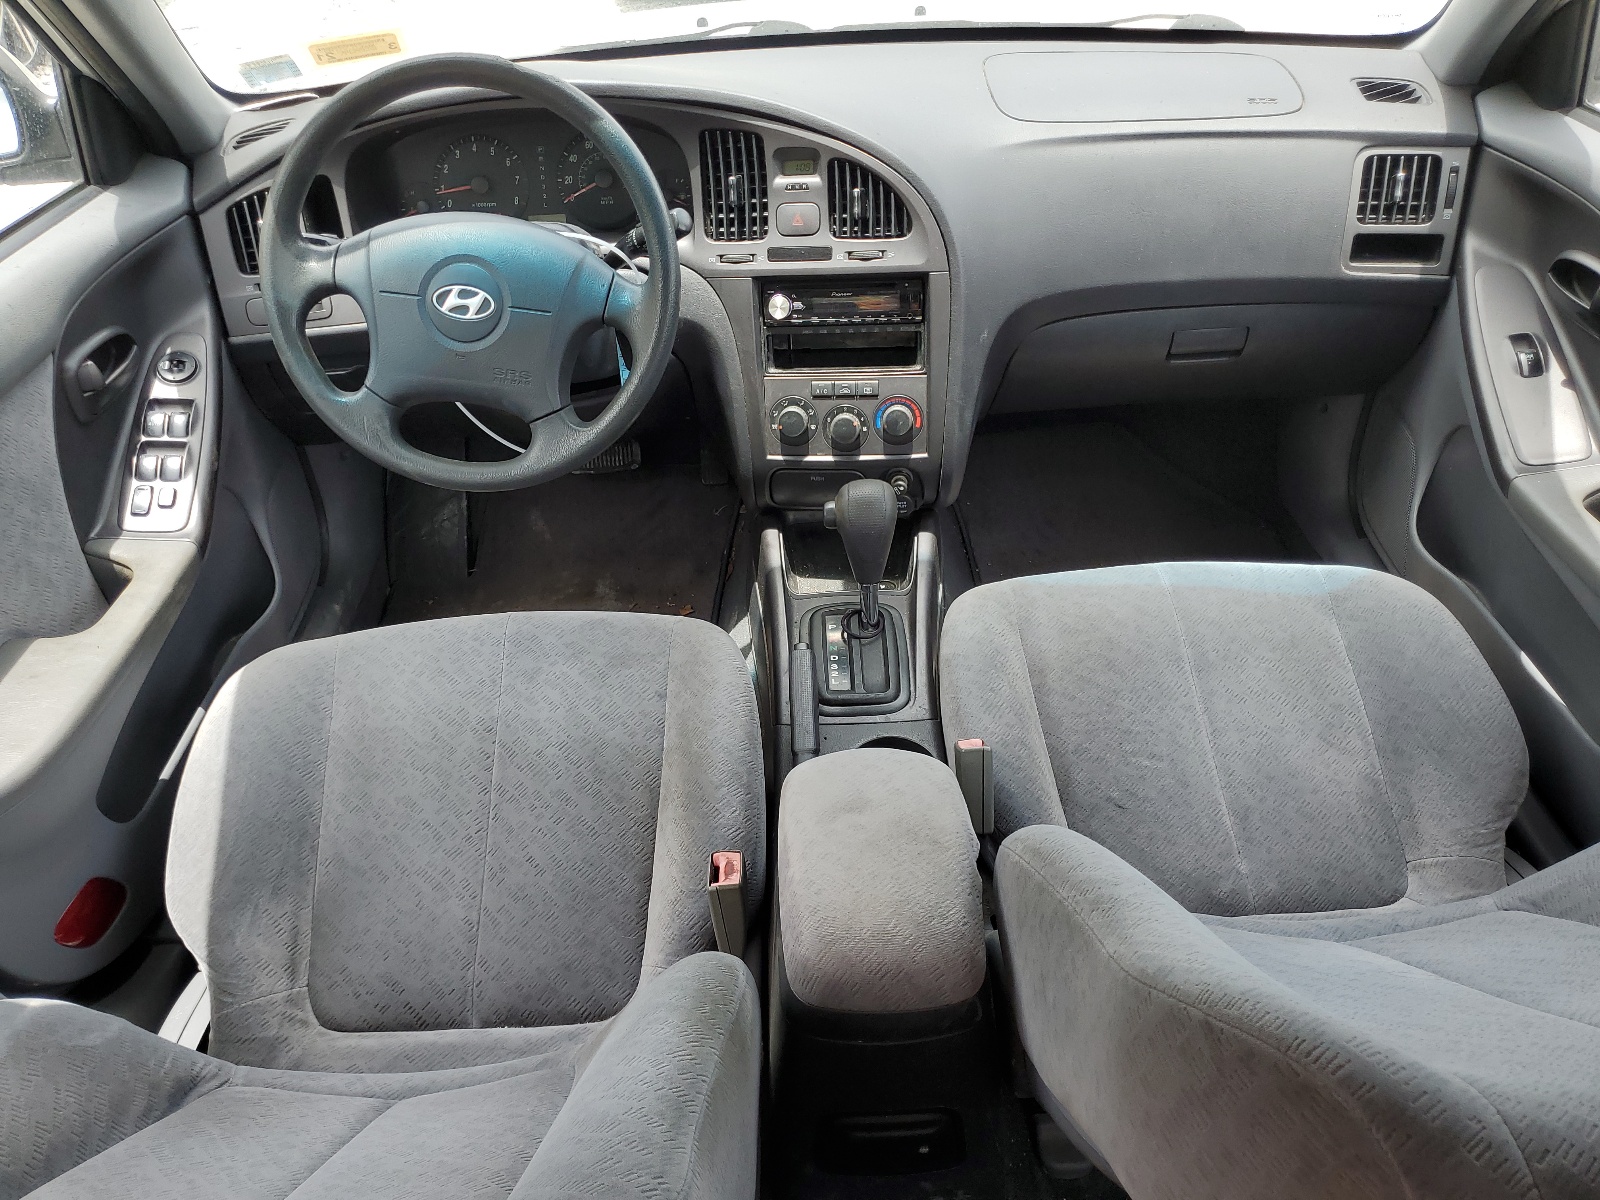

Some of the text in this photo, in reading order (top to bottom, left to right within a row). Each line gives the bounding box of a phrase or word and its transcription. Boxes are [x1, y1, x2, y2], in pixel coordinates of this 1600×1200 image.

[472, 143, 476, 152] 4
[490, 147, 494, 156] 5
[456, 150, 460, 158] 3
[506, 158, 510, 166] 6
[444, 164, 448, 173] 2
[515, 176, 519, 184] 7
[564, 176, 572, 184] 20
